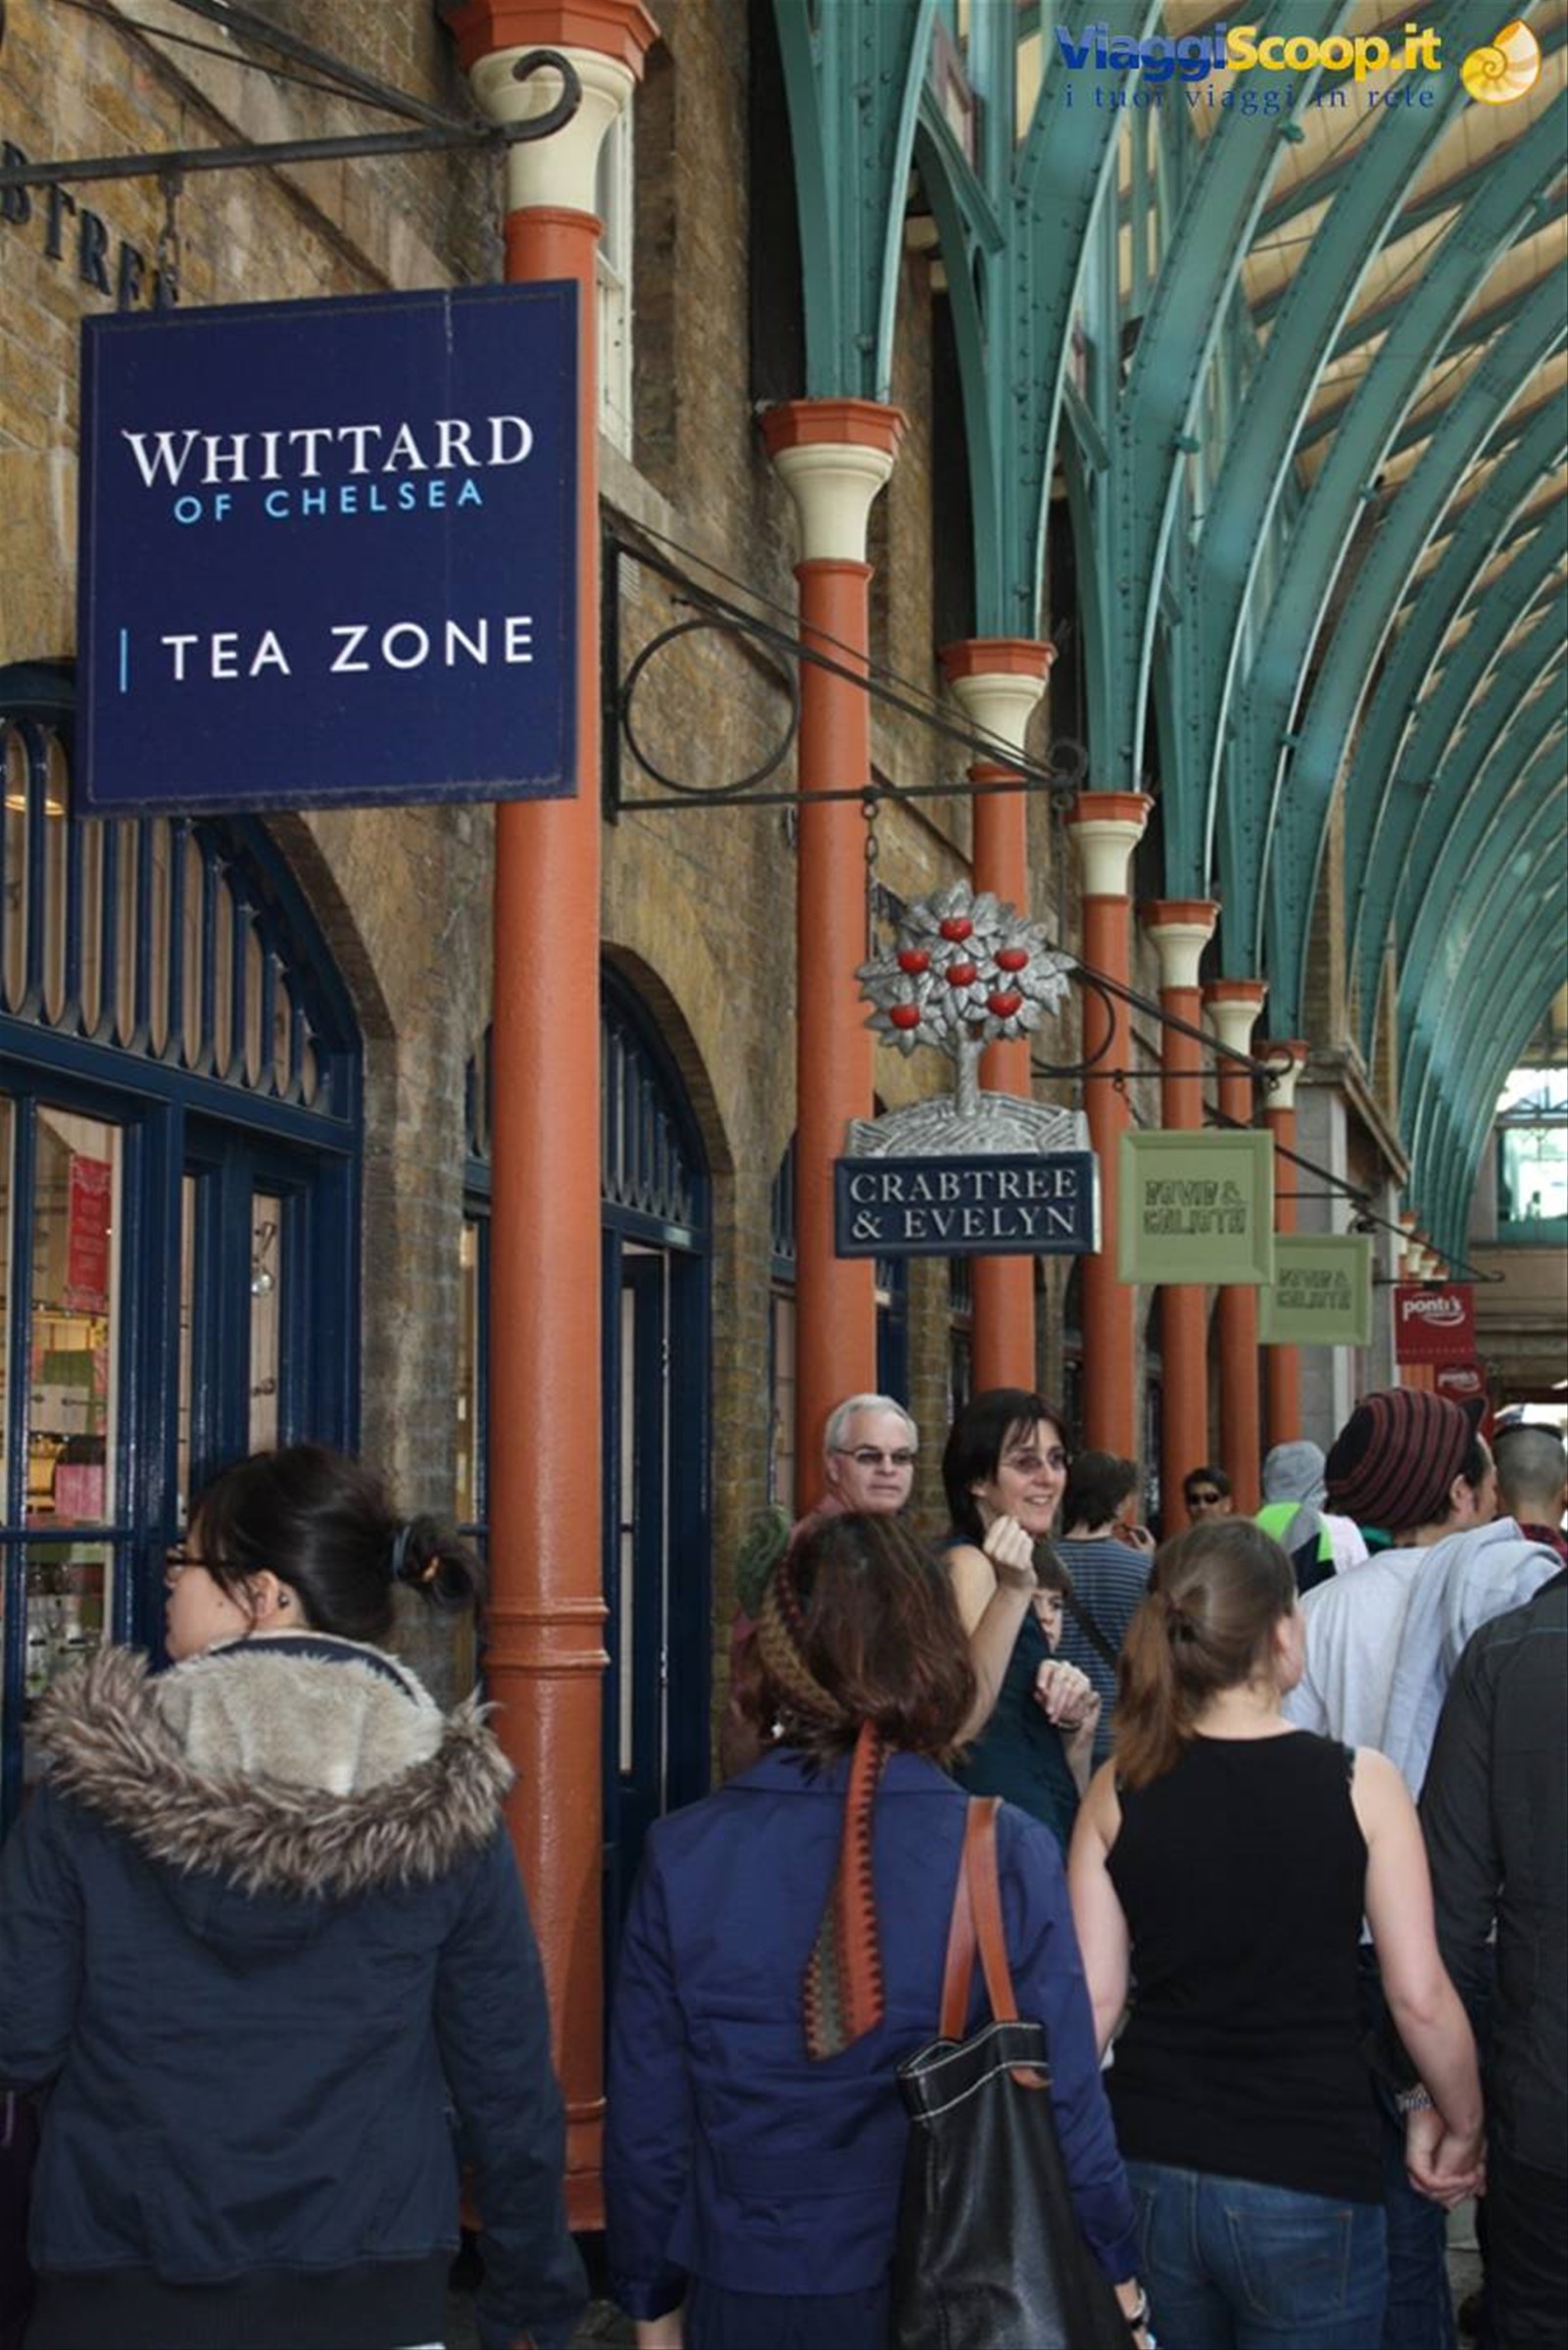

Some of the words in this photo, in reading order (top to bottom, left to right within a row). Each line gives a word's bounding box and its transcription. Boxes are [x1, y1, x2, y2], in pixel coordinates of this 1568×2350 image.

[122, 416, 534, 488] WHITTARD
[174, 493, 232, 523] OF
[265, 479, 483, 518] CHELSEA
[162, 630, 291, 680] TEA
[329, 615, 533, 672] ZONE
[850, 1168, 1077, 1203] CRABTREE
[852, 1209, 881, 1240] &
[904, 1205, 1075, 1239] EVELYN
